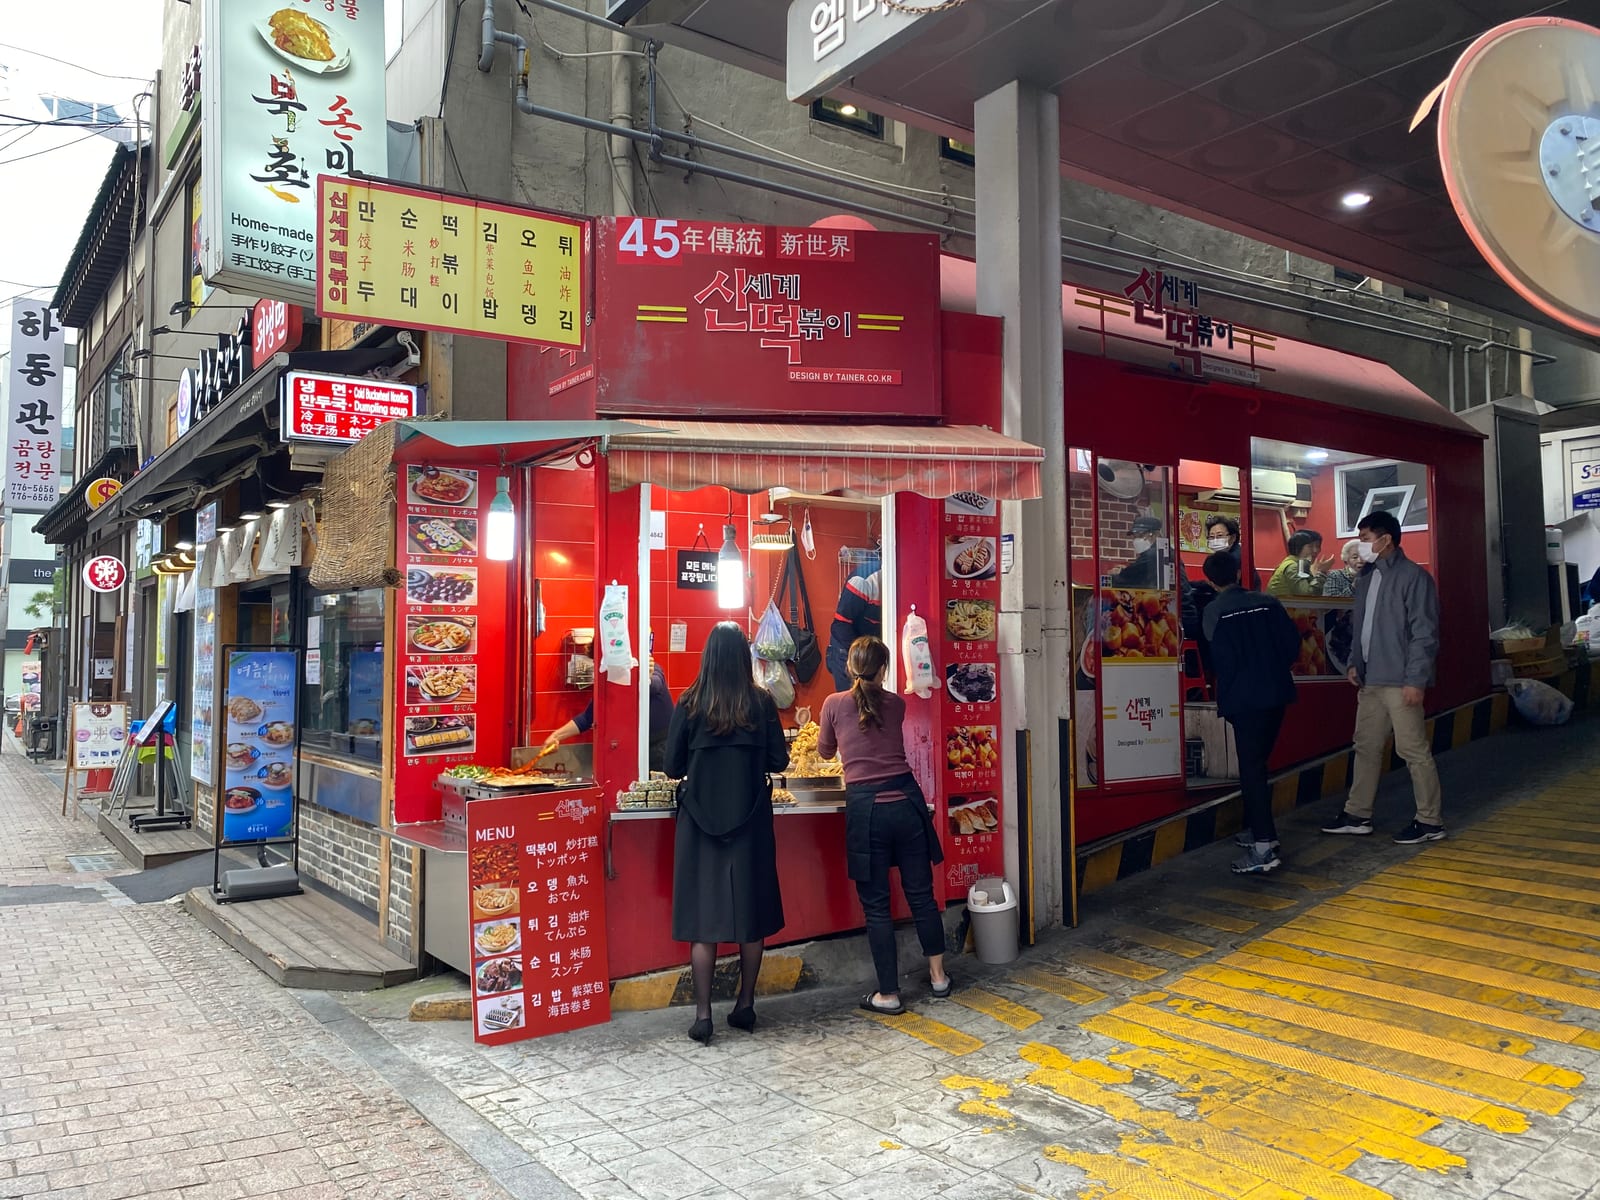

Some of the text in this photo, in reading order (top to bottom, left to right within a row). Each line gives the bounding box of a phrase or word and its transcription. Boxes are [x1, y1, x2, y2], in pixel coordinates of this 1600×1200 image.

[231, 212, 314, 243] Home-made
[780, 231, 851, 258] 新世界
[16, 307, 60, 435] 하동관
[790, 371, 892, 383] DESIGN BY TAINER.CO.KR
[354, 387, 365, 399] Cold
[299, 394, 347, 411] 만두국
[354, 400, 408, 417] Dumpling soup
[12, 439, 56, 459] 곰탕
[11, 483, 54, 493] 776-5656
[11, 491, 54, 502] 776-6565
[33, 568, 52, 577] the
[475, 825, 515, 842] MENU
[526, 841, 557, 856] 떡볶이
[537, 851, 589, 869] トッポッキ
[567, 873, 589, 887] 魚丸
[548, 890, 580, 904] おでん
[568, 909, 590, 924] 油炸
[551, 961, 584, 979] スンデ
